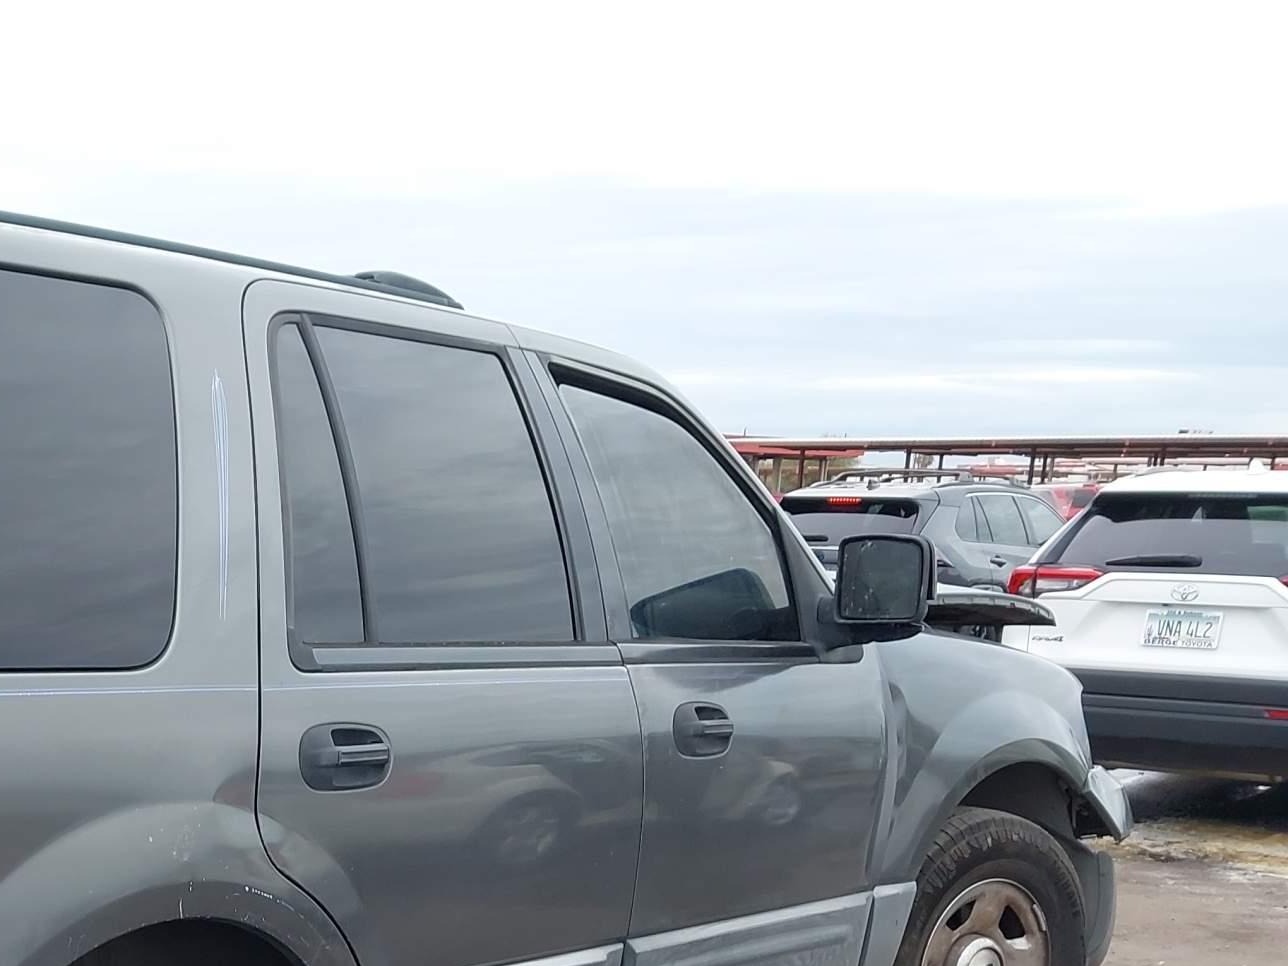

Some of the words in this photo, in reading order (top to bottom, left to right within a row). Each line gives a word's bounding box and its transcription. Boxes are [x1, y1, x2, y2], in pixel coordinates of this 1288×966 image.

[1157, 619, 1182, 637] VNA
[1186, 620, 1213, 639] 4L2
[1182, 639, 1213, 649] TOYOTA
